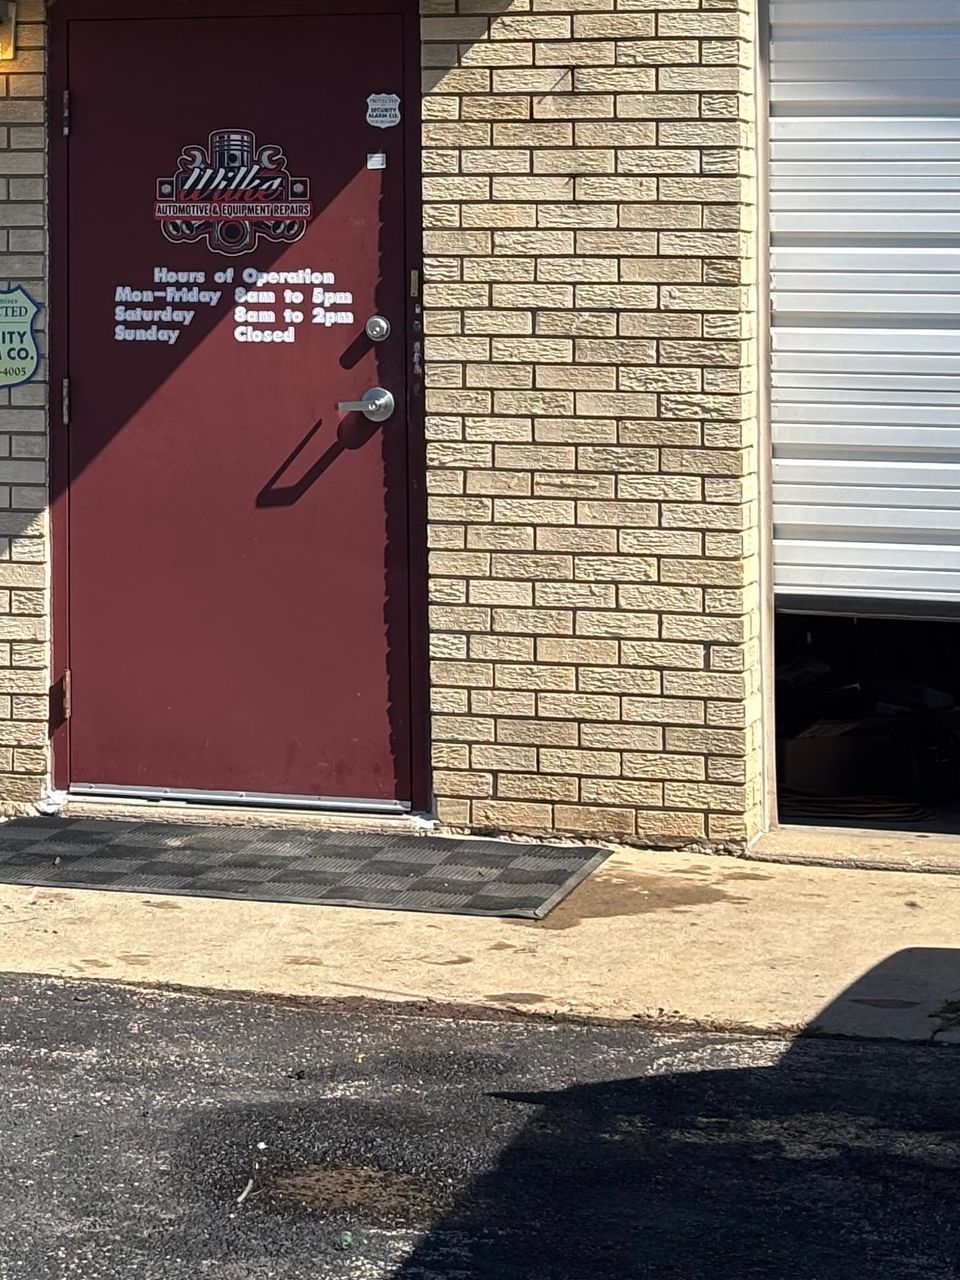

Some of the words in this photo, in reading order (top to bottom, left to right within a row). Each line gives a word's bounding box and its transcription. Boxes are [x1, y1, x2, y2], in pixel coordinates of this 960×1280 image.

[179, 165, 284, 202] Wilke
[156, 203, 209, 217] AUTOMOTIVE
[211, 203, 220, 216] &
[222, 203, 271, 218] EQUIPMENT
[273, 203, 310, 217] REPAIRS
[153, 267, 206, 283] Hours
[214, 267, 234, 283] of
[242, 268, 335, 287] Operation
[114, 286, 222, 306] Mon-Friday
[234, 287, 276, 304] 8am
[284, 289, 304, 304] to
[312, 288, 353, 307] 5pm
[114, 306, 195, 325] Saturday
[234, 306, 276, 323] 8am
[284, 308, 304, 323] to
[312, 307, 354, 327] 2pm
[114, 325, 180, 344] Sunday
[234, 326, 295, 343] Closed
[7, 347, 34, 360] CO.
